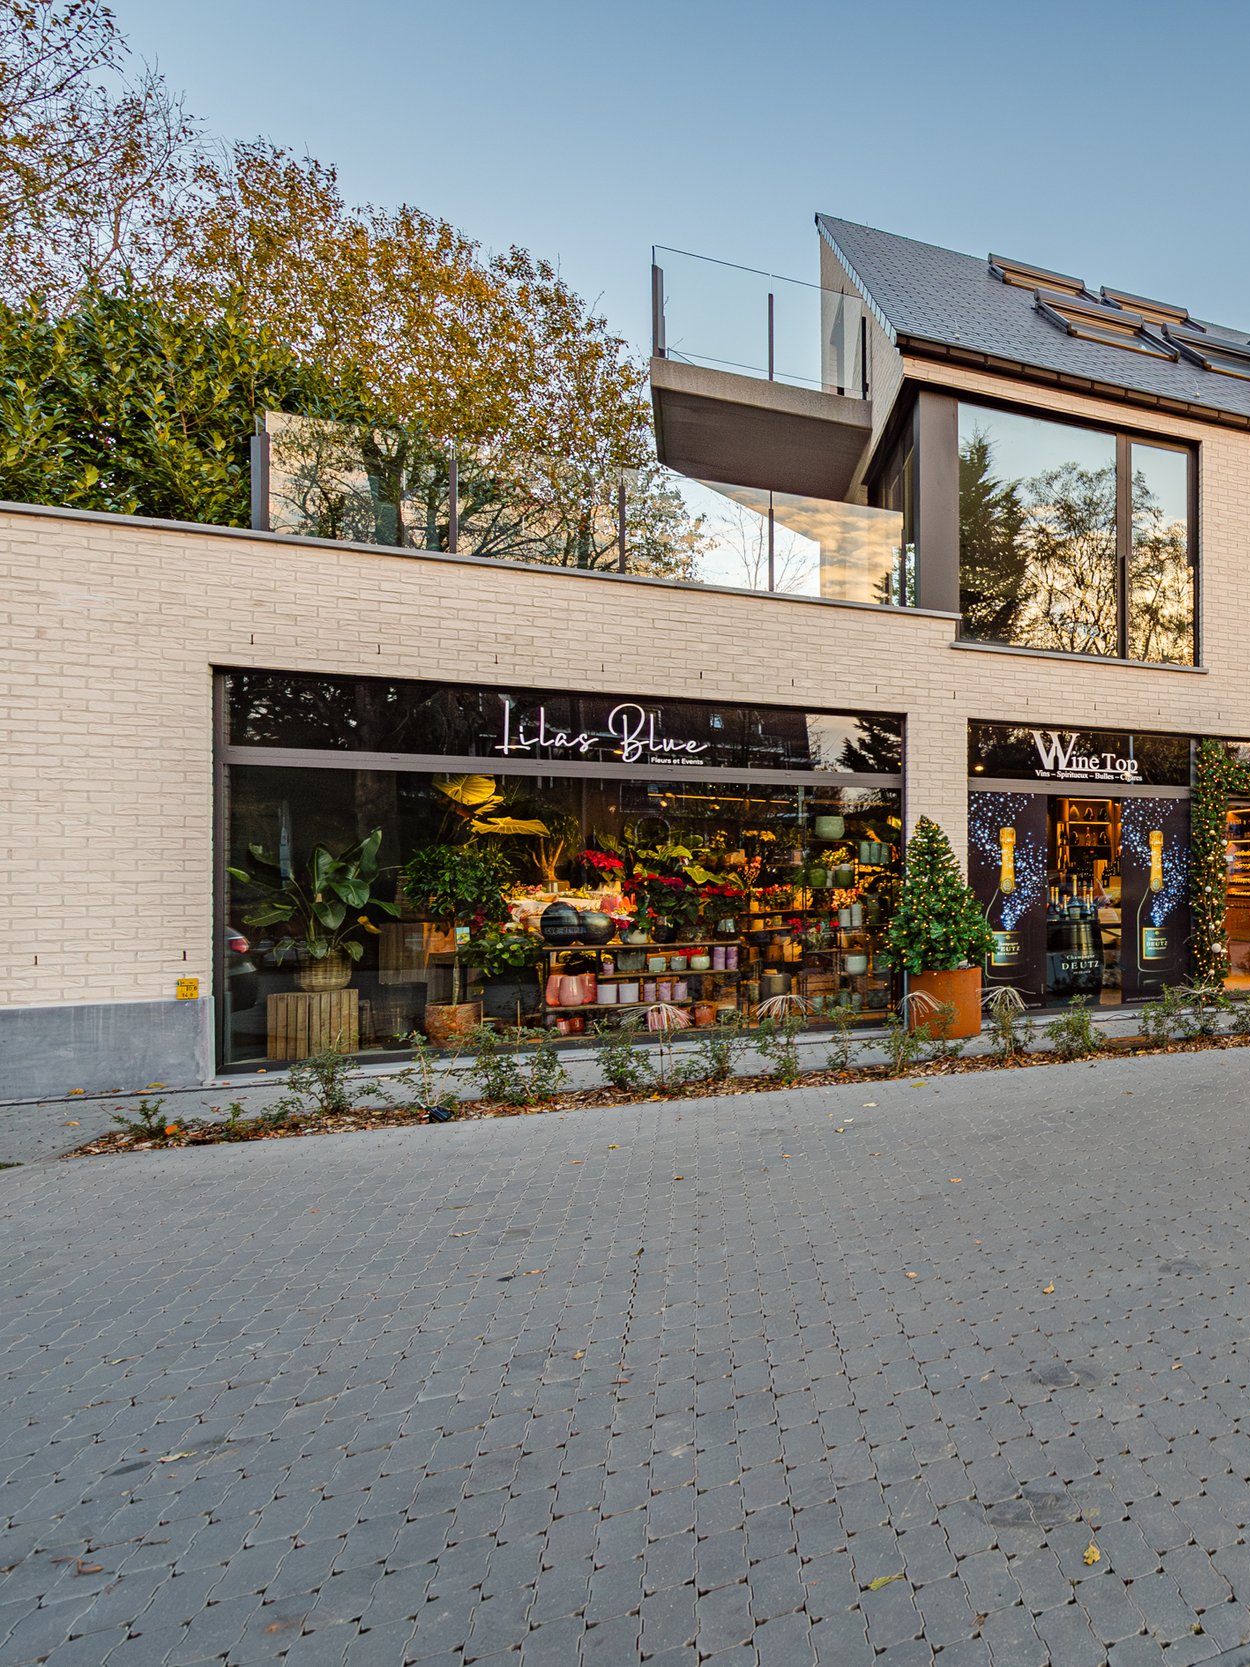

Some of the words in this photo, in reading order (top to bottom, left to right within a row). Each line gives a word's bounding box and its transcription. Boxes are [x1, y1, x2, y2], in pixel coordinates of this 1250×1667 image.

[495, 700, 599, 755] Lilas
[608, 703, 708, 763] Blue
[1029, 730, 1100, 770] Wine
[1101, 753, 1138, 774] Top
[651, 756, 671, 764] Fleurs
[681, 757, 704, 765] Events
[1035, 769, 1050, 777] Vins
[1095, 772, 1114, 780] Bulles
[1061, 960, 1100, 970] DEUTZ
